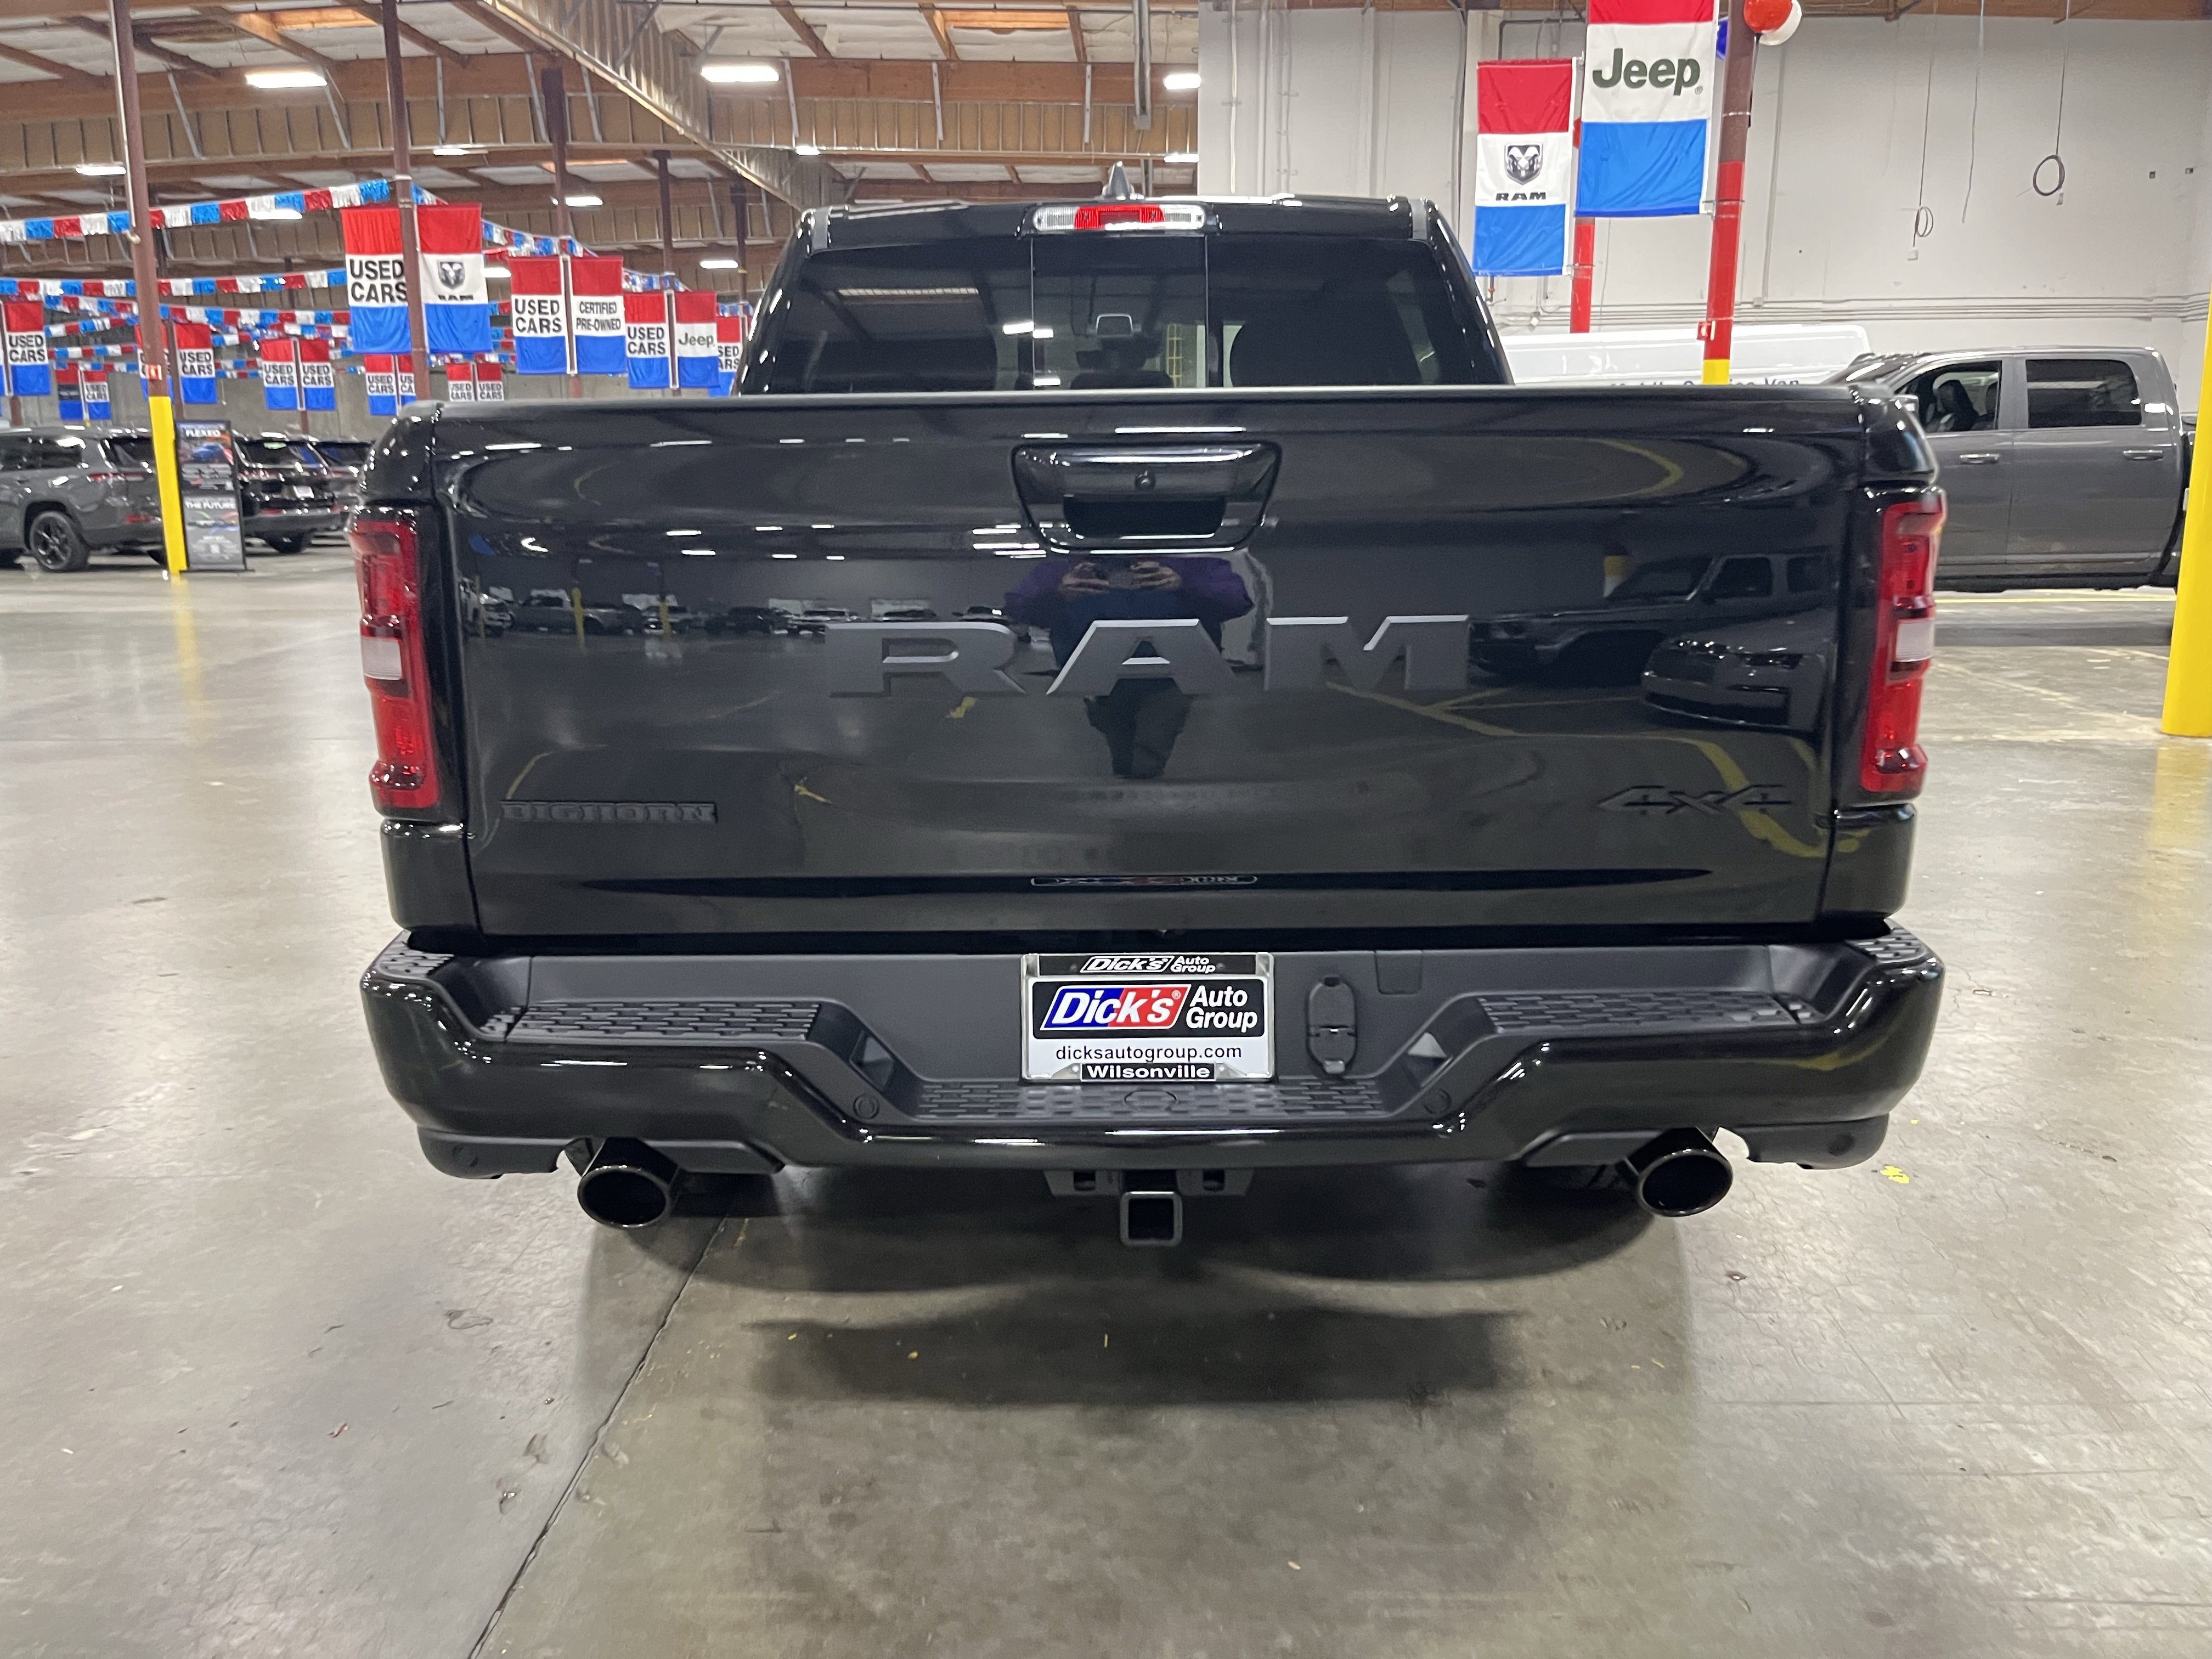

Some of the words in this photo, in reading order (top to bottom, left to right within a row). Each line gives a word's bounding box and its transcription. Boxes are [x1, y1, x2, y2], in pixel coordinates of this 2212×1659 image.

[1592, 48, 1700, 95] Jeep
[1496, 192, 1546, 201] RAM
[349, 259, 404, 280] USED
[351, 282, 407, 303] CARS
[515, 298, 560, 315] USED
[579, 302, 617, 314] CERTIFIED
[516, 317, 562, 334] CARS
[576, 318, 620, 331] PRE-OWNED
[628, 326, 664, 340] USED
[9, 335, 44, 347] USED
[678, 332, 714, 348] Jeep
[628, 342, 665, 355] CARS
[717, 346, 739, 357] SED
[9, 349, 45, 362] CARS
[179, 352, 212, 363] USED
[181, 364, 212, 376] CARS
[264, 364, 292, 374] USED
[303, 364, 329, 375] USED
[266, 375, 294, 385] CARS
[303, 375, 332, 385] CARS
[368, 375, 392, 383] USED
[400, 375, 413, 383] US
[369, 385, 393, 393] CARS
[400, 385, 413, 393] CA
[825, 615, 1469, 696] RAM
[1087, 957, 1164, 970] Dick's
[1173, 956, 1209, 965] Auto
[1170, 964, 1216, 973] Group
[1052, 990, 1173, 1024] Dick's
[1190, 985, 1248, 1007] Auto
[1186, 1007, 1258, 1033] Group
[1056, 1045, 1242, 1062] dicksautogroup.com
[1087, 1065, 1210, 1078] Wilsonville
